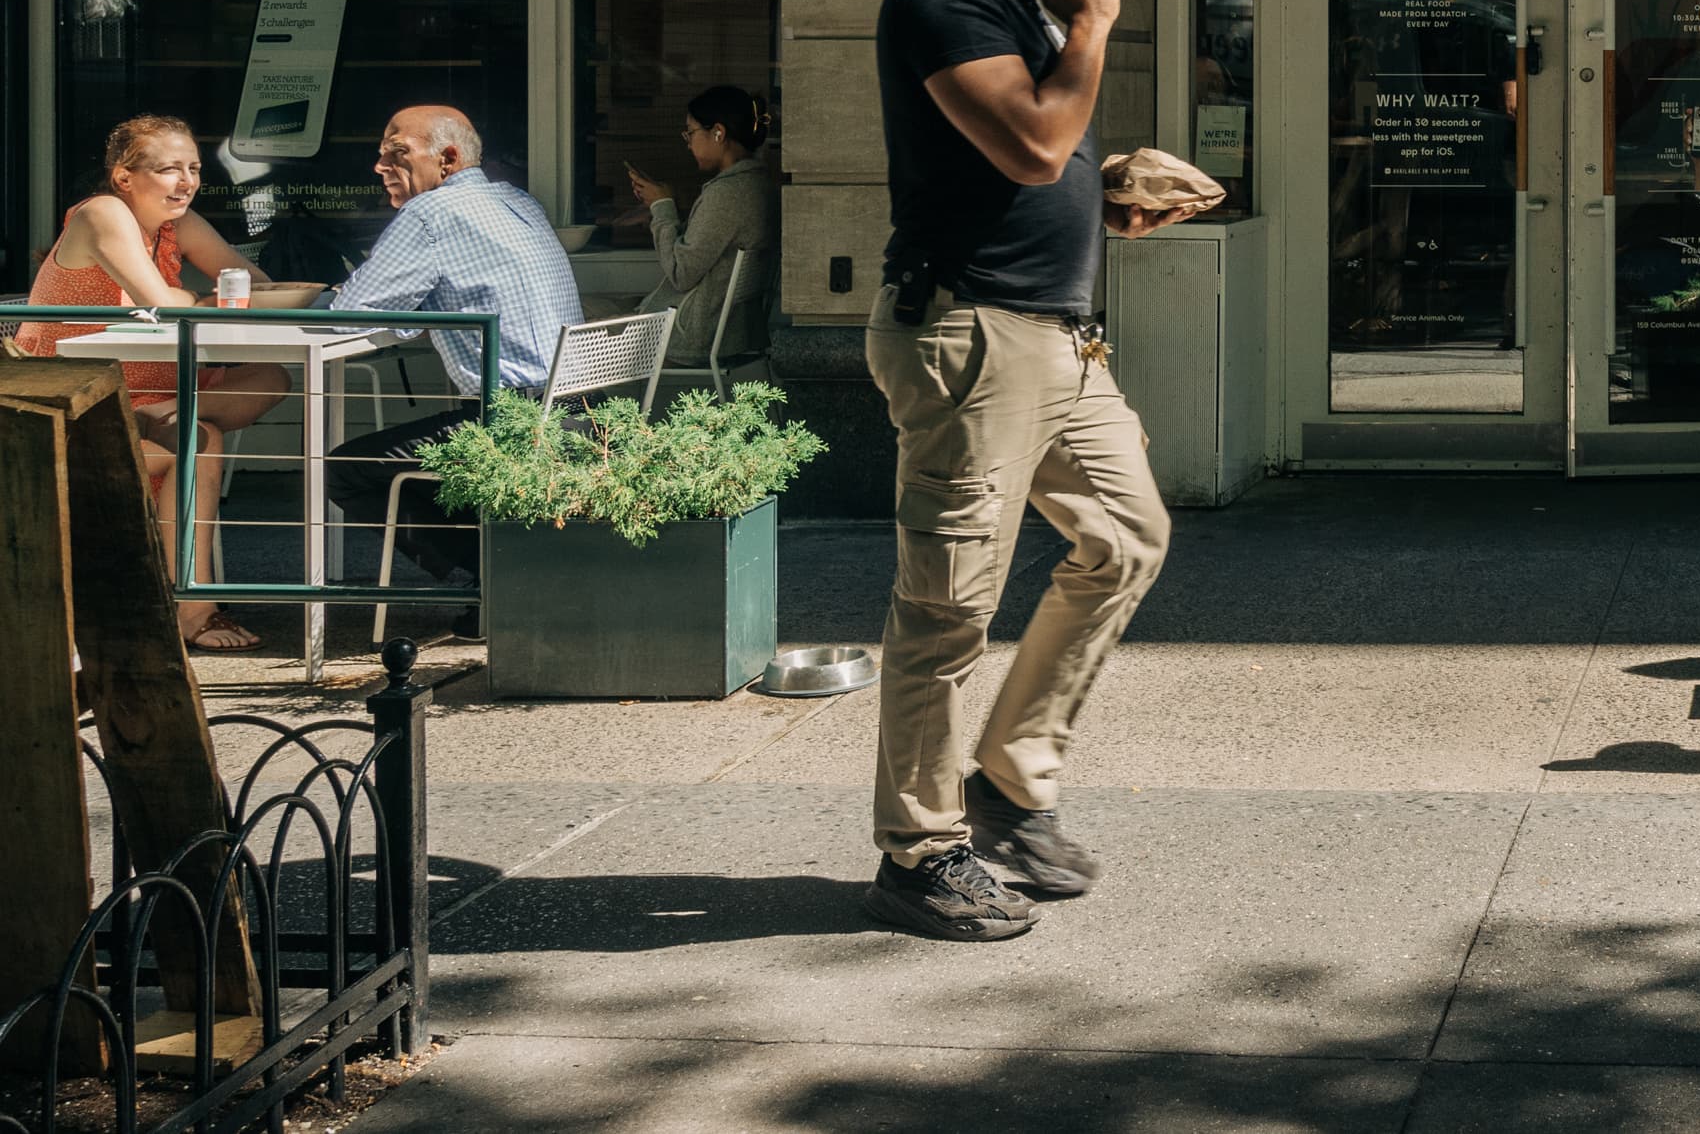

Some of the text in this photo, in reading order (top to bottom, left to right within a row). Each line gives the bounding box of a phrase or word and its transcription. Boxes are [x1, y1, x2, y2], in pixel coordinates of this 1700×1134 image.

[270, 0, 307, 10] rewards
[267, 18, 315, 29] challenges
[1376, 94, 1480, 107] WHY WAIT?
[1375, 118, 1401, 127] Order
[1404, 118, 1411, 127] in
[1432, 118, 1469, 127] seconds
[1471, 119, 1481, 127] or
[1204, 130, 1237, 138] WE'RE
[1372, 133, 1484, 144] less with the sweetgreen
[1201, 140, 1239, 148] HIRING!
[1401, 147, 1455, 158] app for iOS.
[200, 184, 228, 195] Earn
[287, 184, 343, 197] birthday
[1391, 314, 1464, 323] Service Animals Only
[1650, 321, 1685, 329] Columbus
